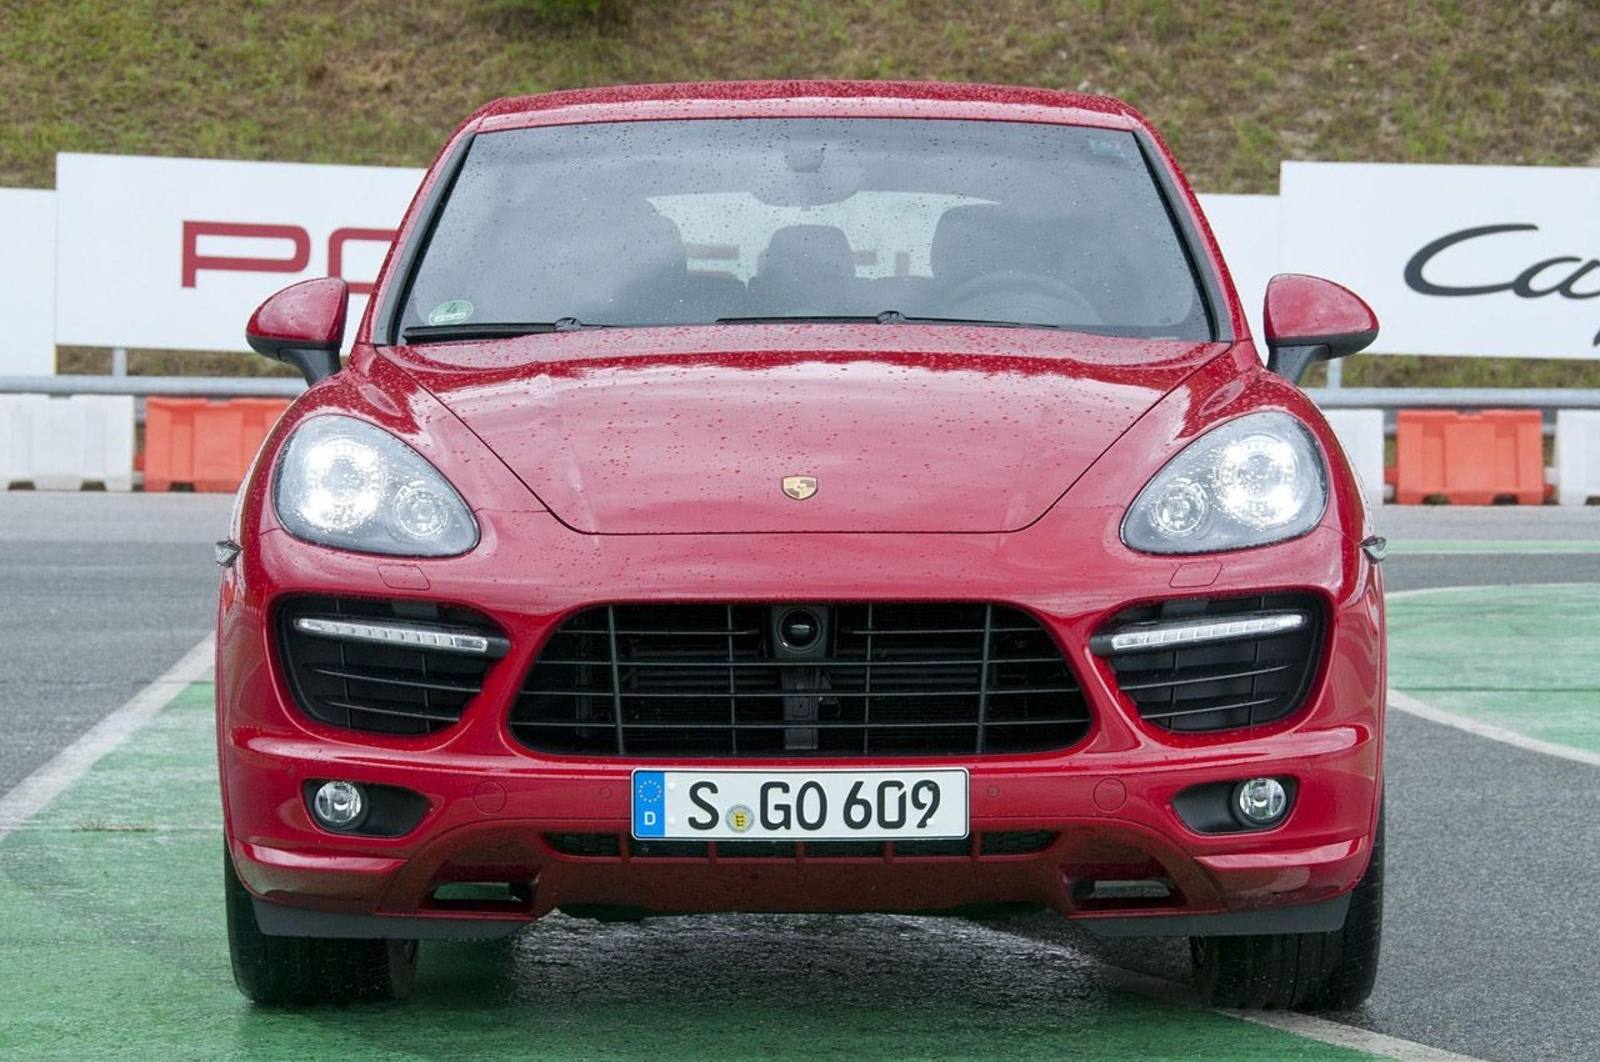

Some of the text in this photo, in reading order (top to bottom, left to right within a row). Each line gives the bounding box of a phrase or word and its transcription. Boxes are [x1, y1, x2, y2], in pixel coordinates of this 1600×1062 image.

[643, 811, 656, 826] D
[687, 779, 941, 831] S GO 609
